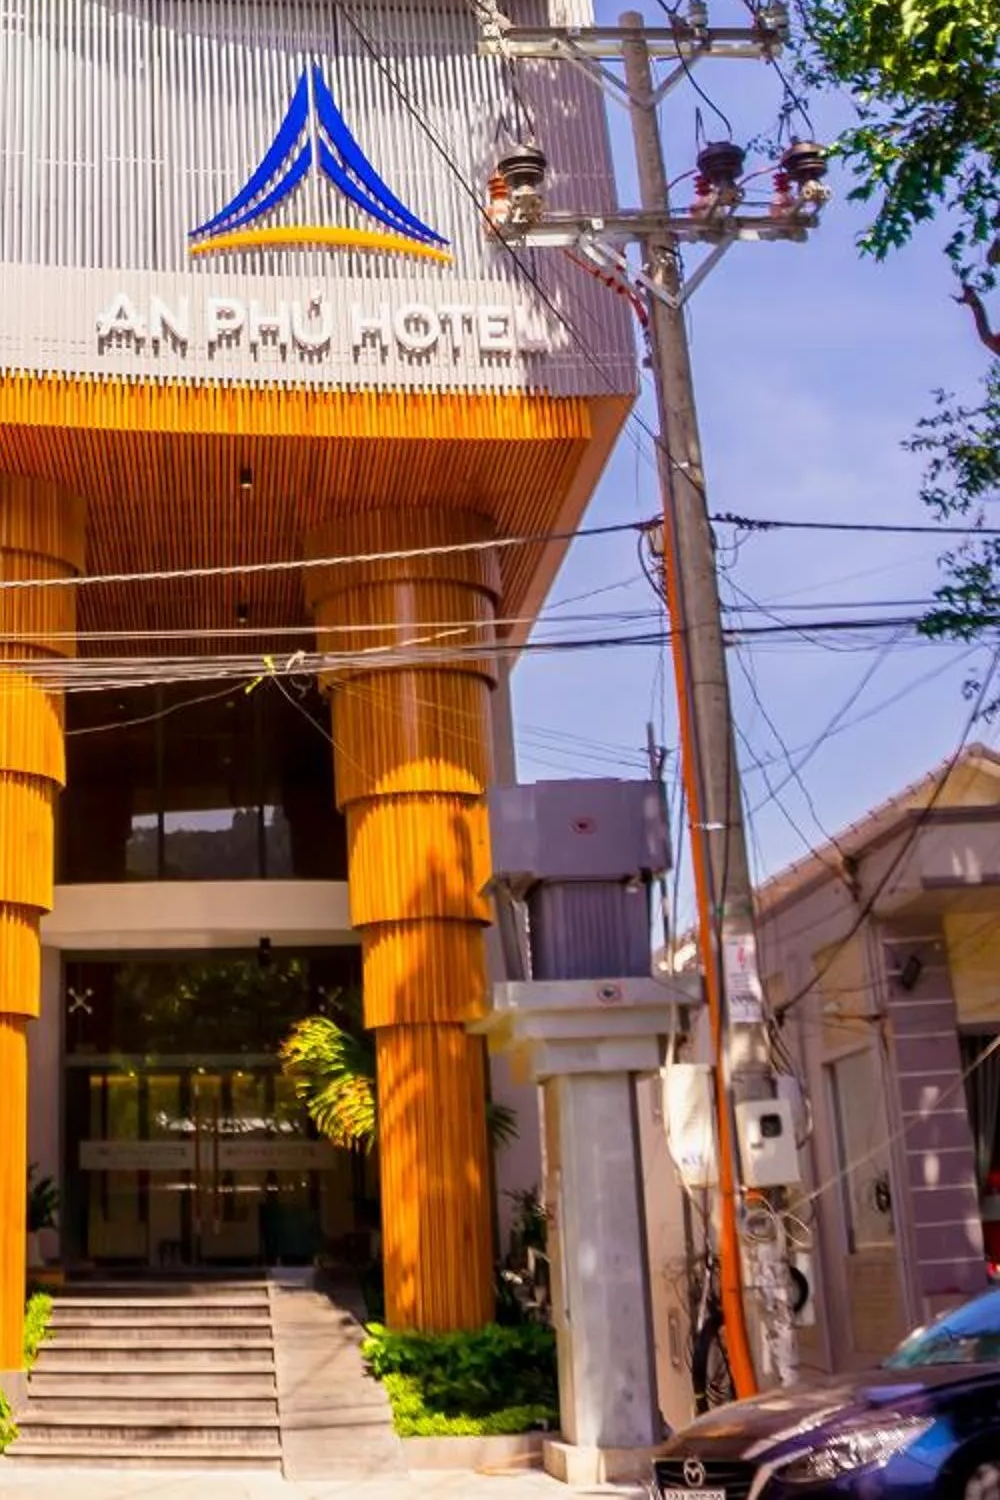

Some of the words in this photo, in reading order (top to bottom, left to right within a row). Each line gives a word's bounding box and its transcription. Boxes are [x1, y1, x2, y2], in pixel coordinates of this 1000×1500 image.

[95, 293, 188, 343] AN
[207, 289, 333, 348] PHÚ
[350, 303, 550, 352] HOTEL
